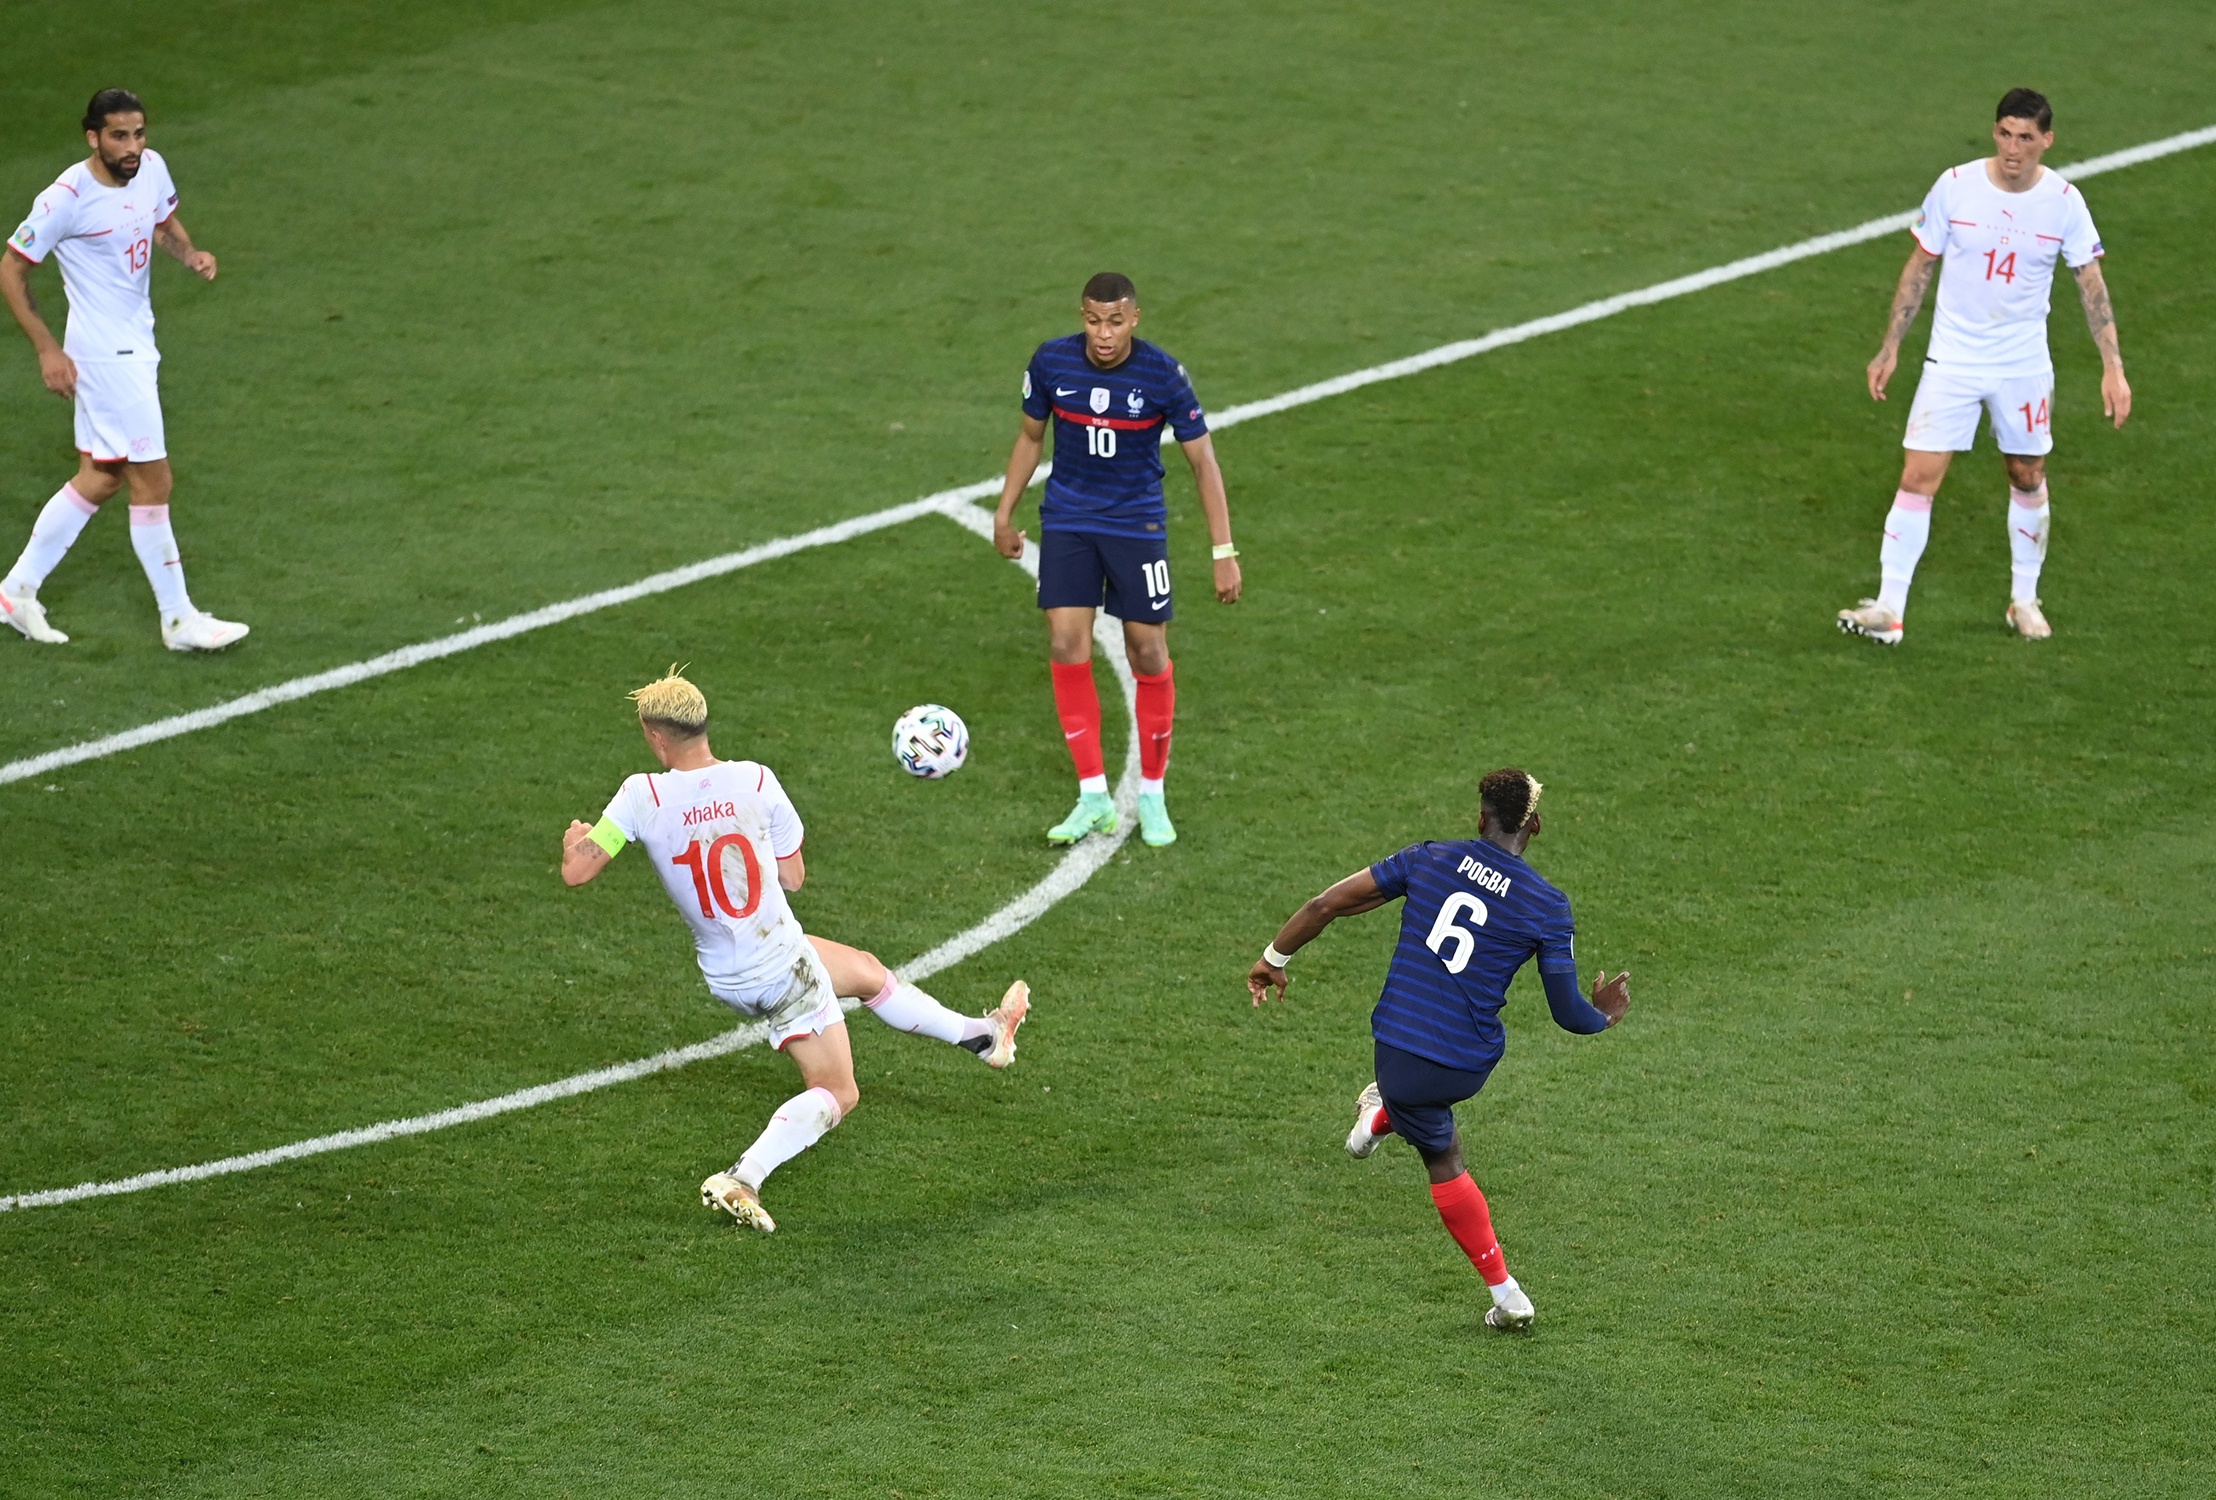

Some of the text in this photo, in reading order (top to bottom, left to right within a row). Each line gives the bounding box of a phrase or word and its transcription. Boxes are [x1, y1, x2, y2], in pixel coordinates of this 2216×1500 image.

[124, 238, 149, 274] 13
[1983, 248, 2017, 285] 14
[2018, 398, 2049, 434] 14
[1085, 424, 1117, 459] 10
[1141, 559, 1171, 599] 10
[682, 801, 736, 827] xhaka
[672, 832, 763, 920] 10
[1456, 855, 1512, 898] POGBA
[1425, 891, 1488, 974] 6
